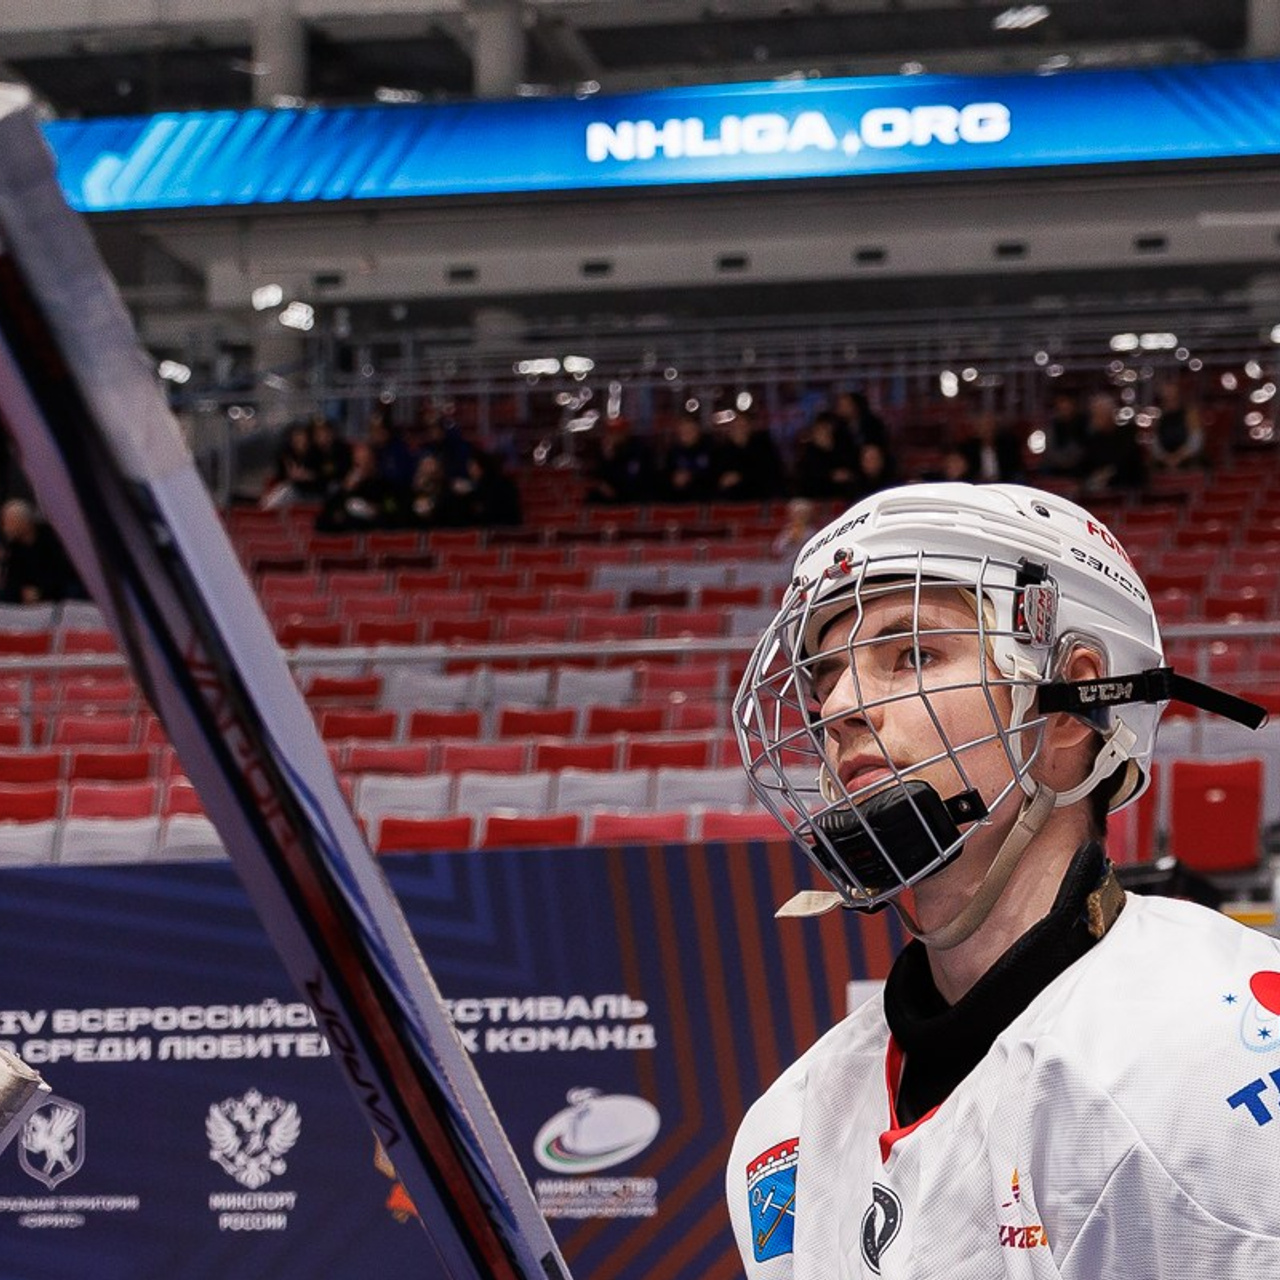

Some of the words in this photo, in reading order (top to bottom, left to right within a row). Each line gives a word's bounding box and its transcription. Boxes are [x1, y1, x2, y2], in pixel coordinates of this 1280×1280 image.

[1078, 682, 1134, 703] CCM
[21, 1037, 151, 1063] СРЕДИ
[485, 1024, 658, 1053] КОМАНД
[304, 972, 402, 1150] VAPOR
